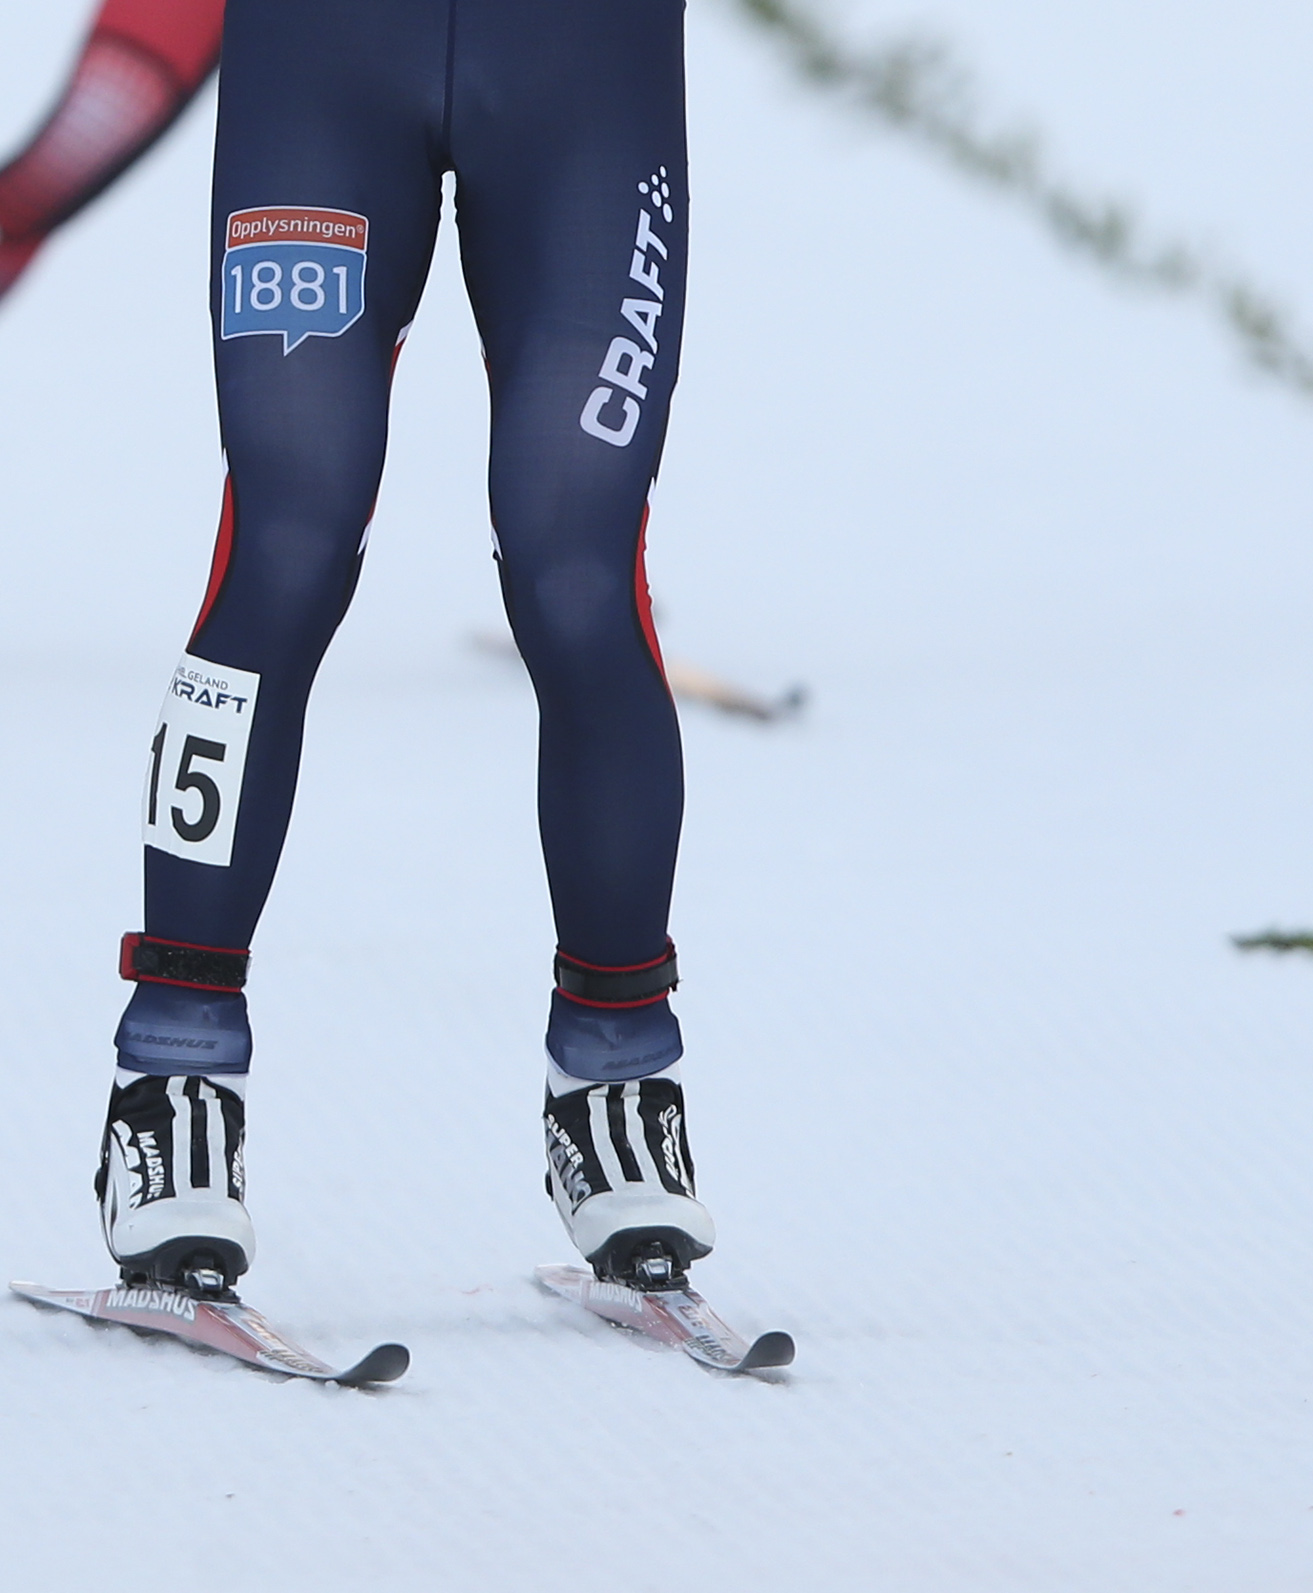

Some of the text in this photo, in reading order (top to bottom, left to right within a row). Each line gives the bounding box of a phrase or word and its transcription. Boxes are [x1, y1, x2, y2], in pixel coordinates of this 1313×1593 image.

[230, 260, 348, 314] 1881
[579, 208, 669, 448] CRAFT
[171, 676, 248, 714] KRAFT
[148, 721, 227, 843] 15
[546, 1113, 585, 1169] SUPER
[106, 1288, 199, 1321] MADSHUS
